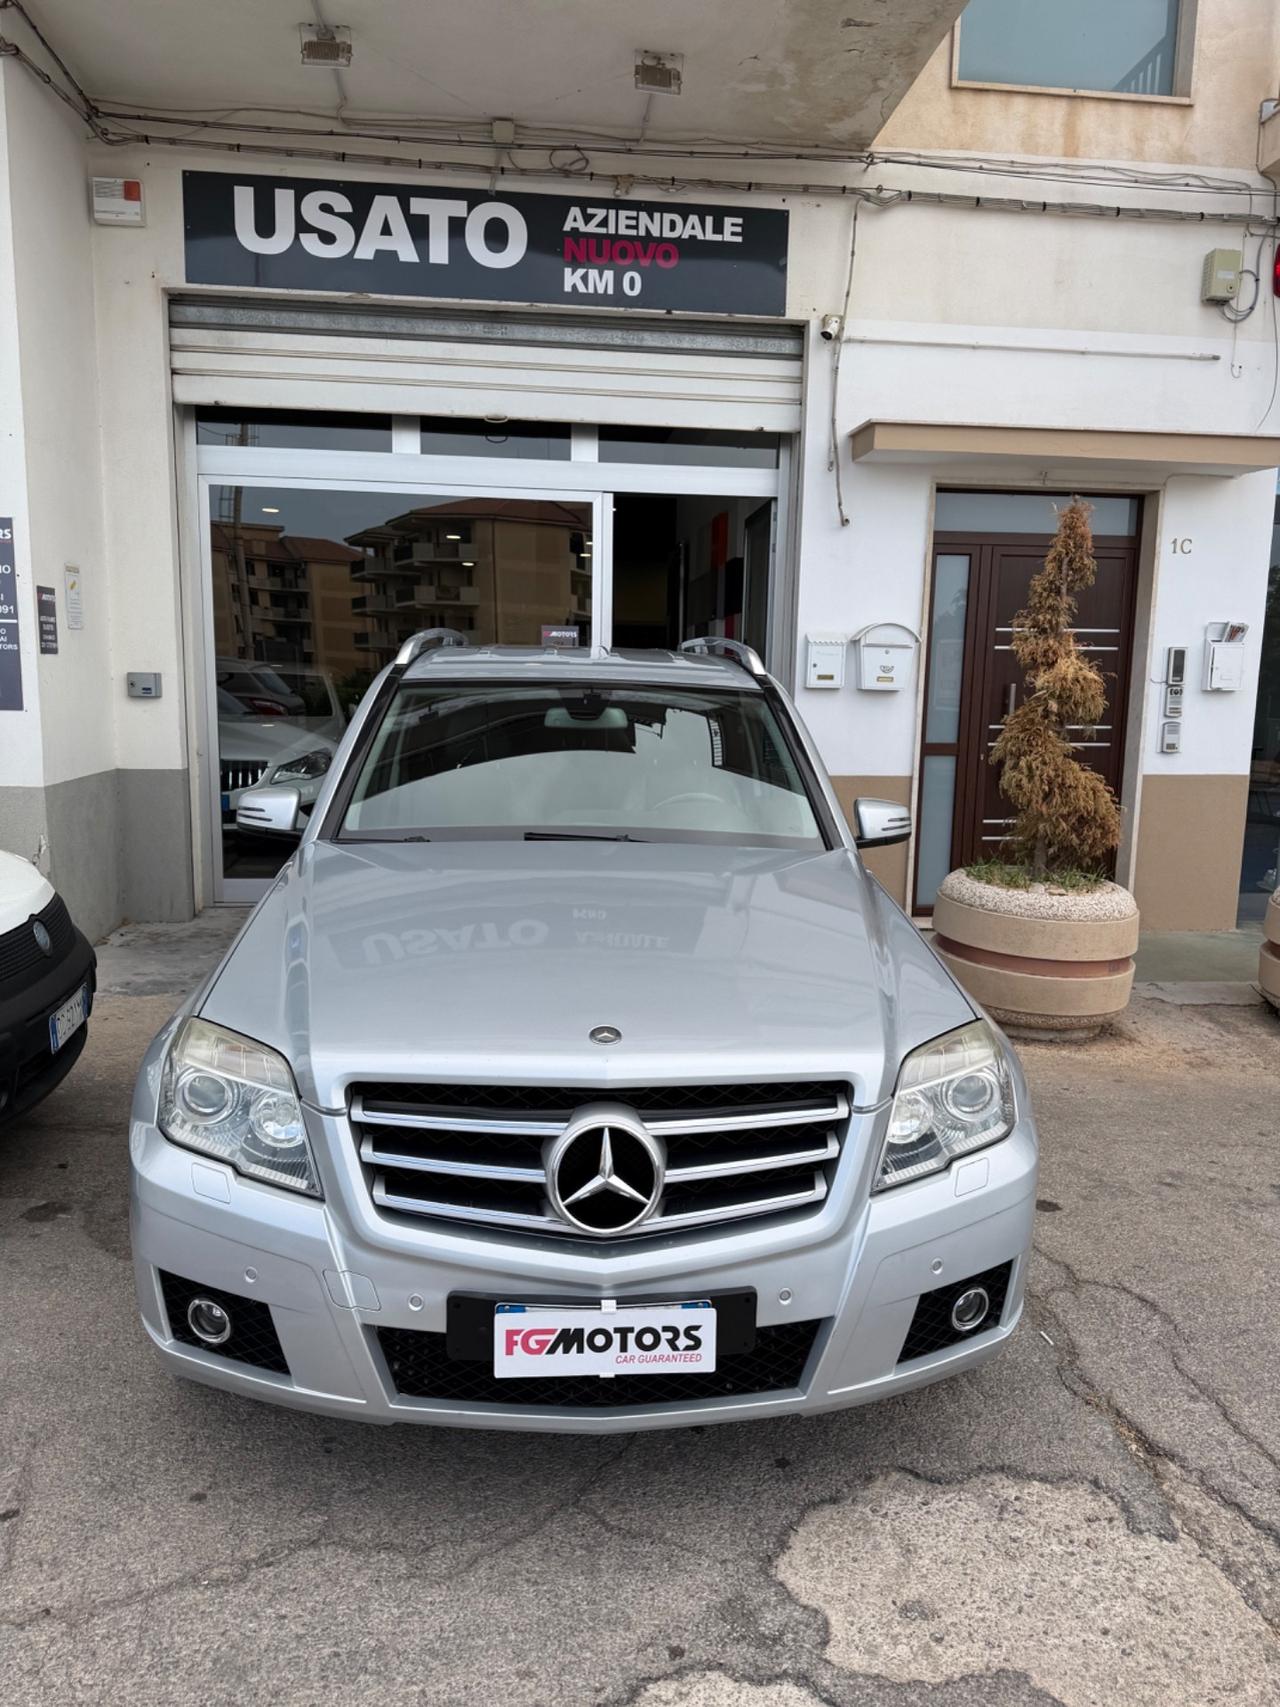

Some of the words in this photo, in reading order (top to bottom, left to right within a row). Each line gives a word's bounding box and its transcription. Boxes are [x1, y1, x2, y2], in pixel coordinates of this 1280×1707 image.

[233, 185, 528, 268] USATO
[563, 206, 743, 242] AZIENDALE
[563, 237, 680, 269] NUOVO
[564, 267, 614, 295] KM
[623, 271, 642, 296] 0
[1171, 537, 1193, 555] 1C
[615, 1354, 636, 1365] CAR
[637, 1353, 702, 1364] GUARANTEED
